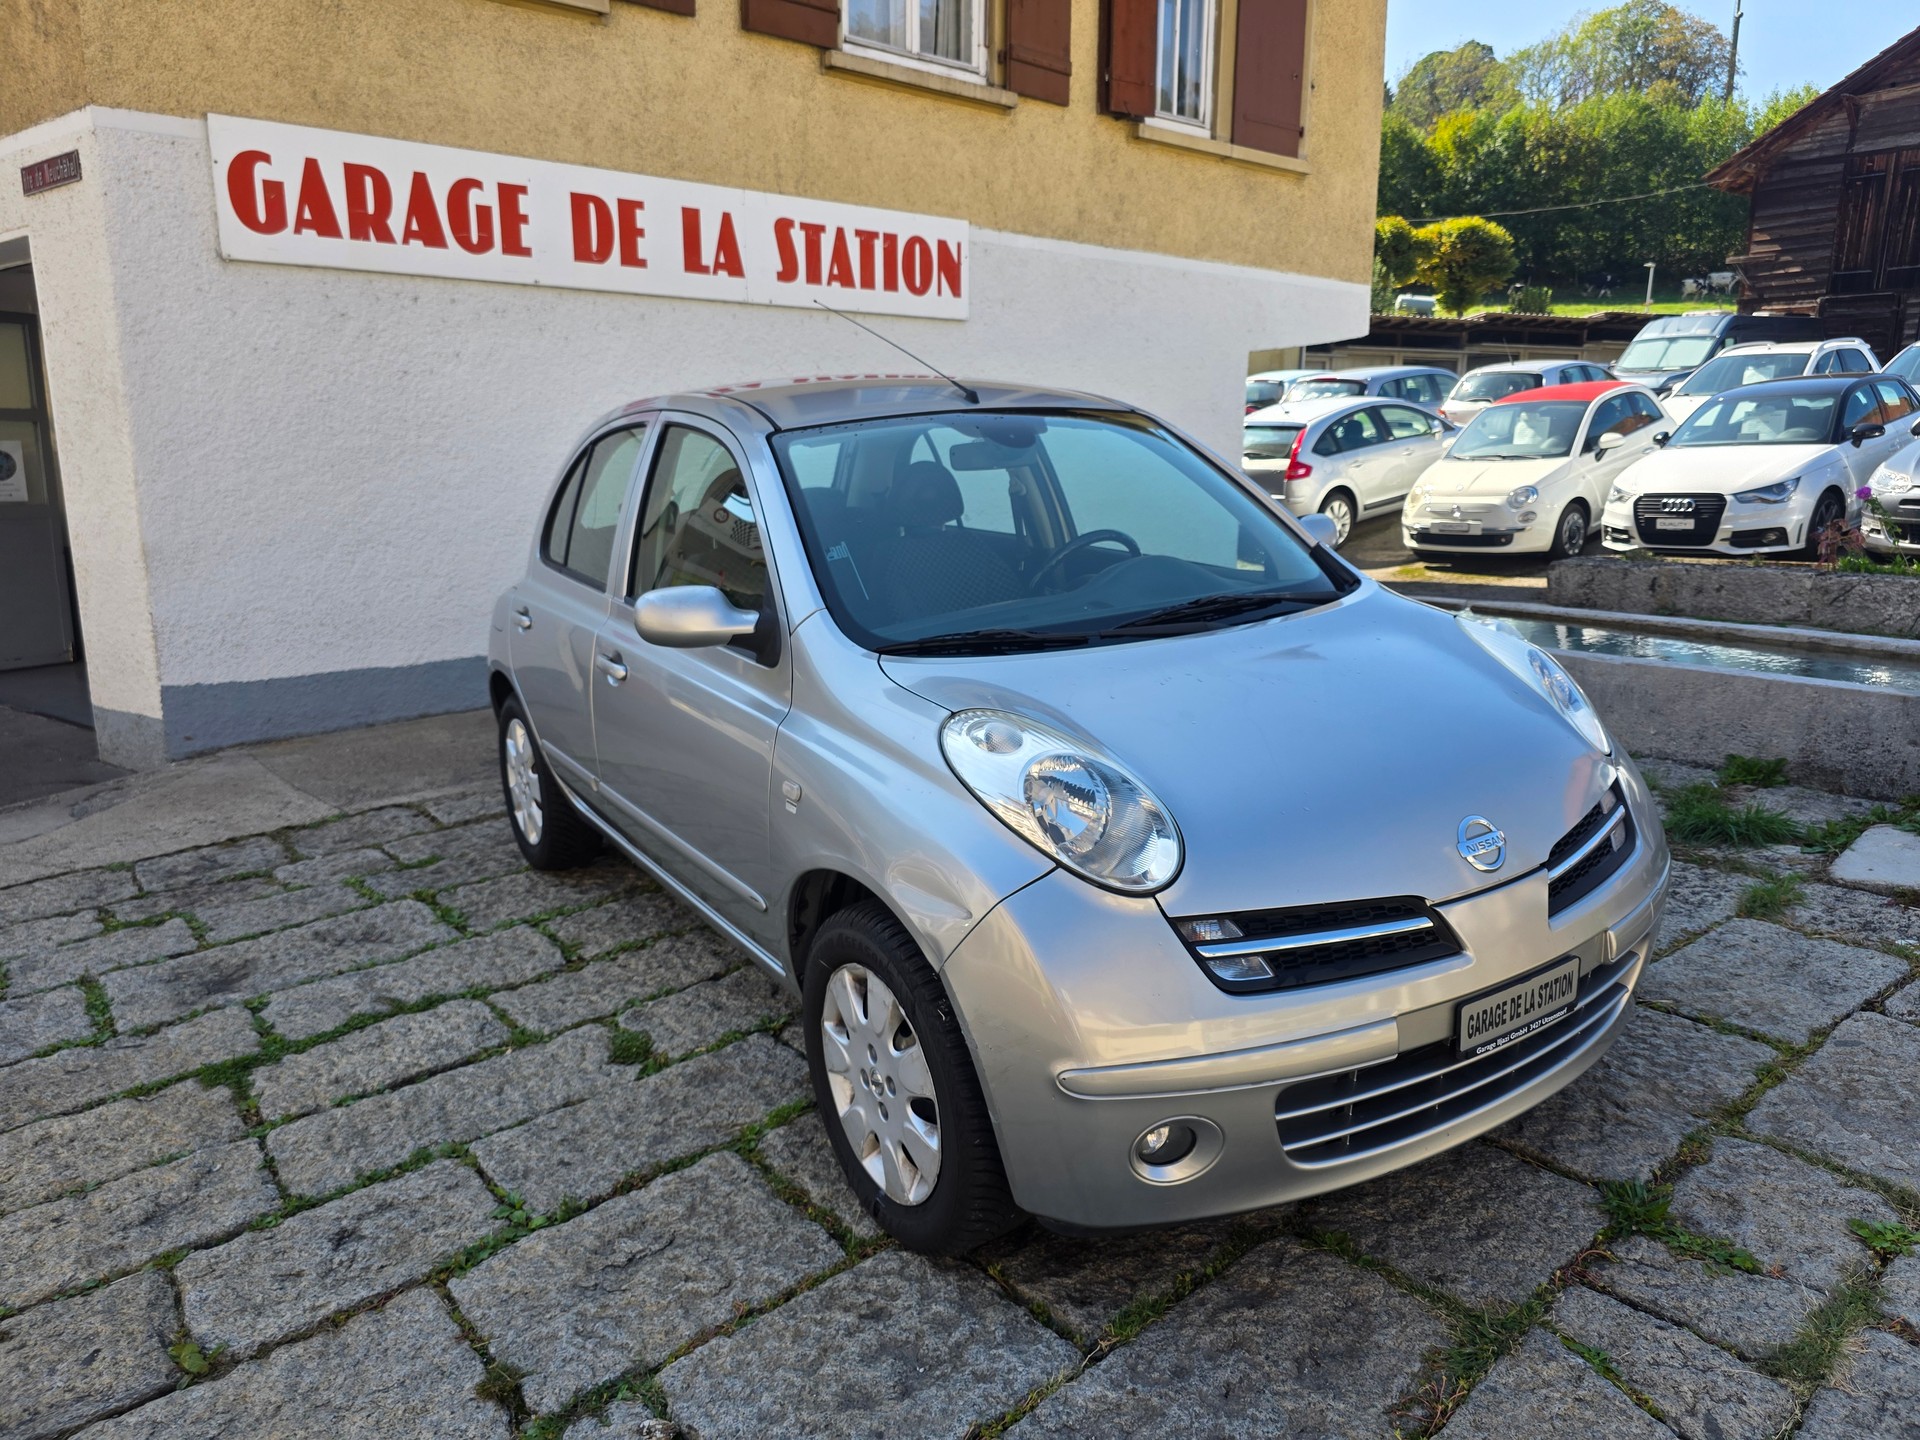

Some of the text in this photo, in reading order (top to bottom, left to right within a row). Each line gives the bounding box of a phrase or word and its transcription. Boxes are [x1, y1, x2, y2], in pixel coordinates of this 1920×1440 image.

[227, 149, 962, 299] GARAGE DE LA STATION
[1465, 834, 1504, 853] NISSAN
[1467, 970, 1574, 1039] GARAGE DE LA STATION
[1476, 1041, 1496, 1055] Garage
[1529, 1018, 1542, 1031] 3427
